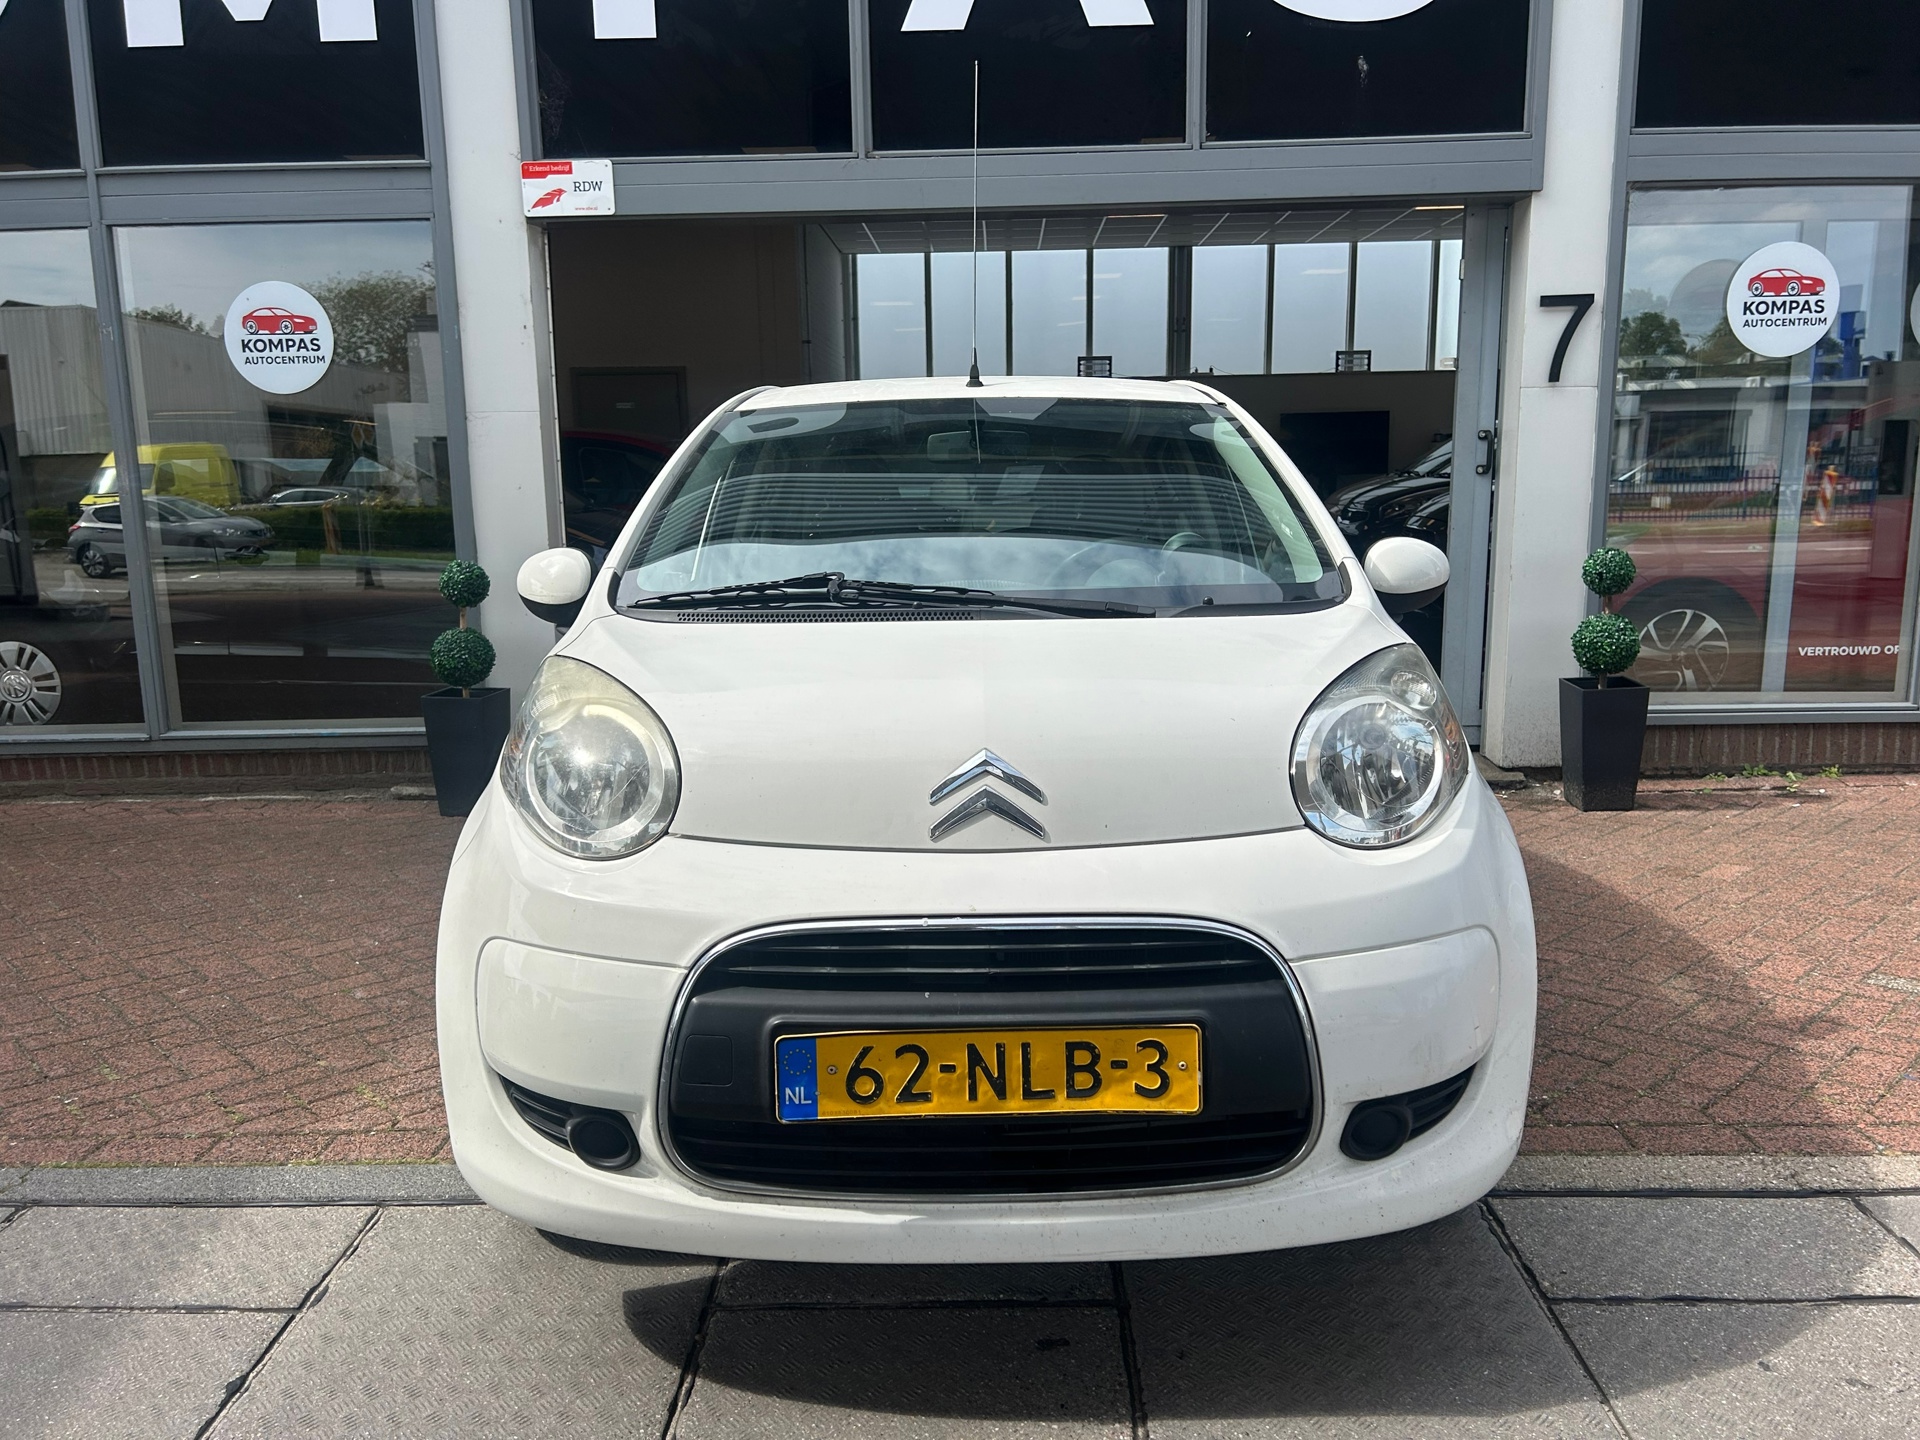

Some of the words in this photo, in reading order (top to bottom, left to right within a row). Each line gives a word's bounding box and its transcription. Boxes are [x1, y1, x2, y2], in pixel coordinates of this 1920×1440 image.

[529, 164, 550, 172] Erkend
[551, 164, 570, 172] bedrijf
[573, 181, 603, 192] RDW
[1743, 299, 1825, 316] KOMPAS
[1743, 317, 1827, 328] AUTOCENTRUM
[1540, 293, 1595, 383] 7
[241, 338, 321, 353] KOMPAS
[244, 355, 326, 365] AUTOCENTRUM
[1798, 645, 1881, 657] VERTROUWD
[845, 1038, 1170, 1105] 62-NLB-3
[785, 1086, 812, 1106] NL
